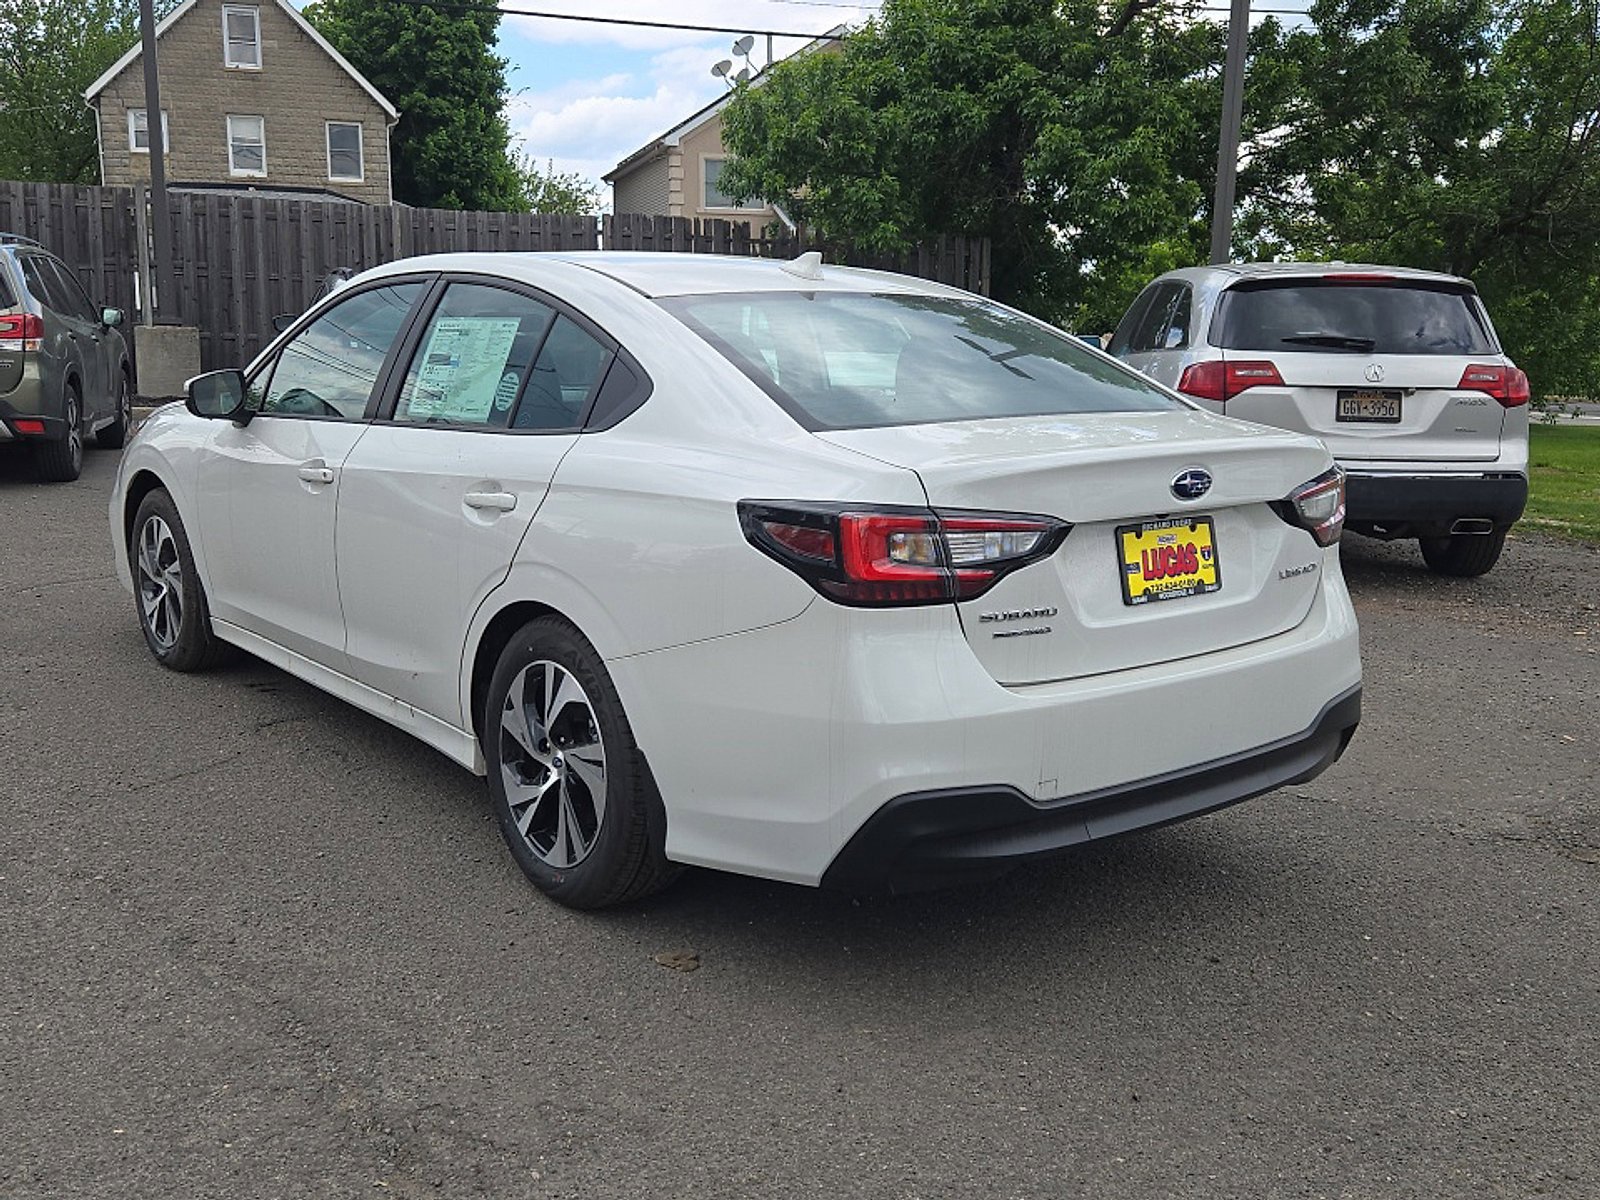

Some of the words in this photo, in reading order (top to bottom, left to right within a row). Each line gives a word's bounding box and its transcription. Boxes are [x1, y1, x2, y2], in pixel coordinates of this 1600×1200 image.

[1369, 400, 1395, 416] 3956
[1142, 542, 1199, 581] LUCAS
[979, 607, 1058, 622] SUBARU
